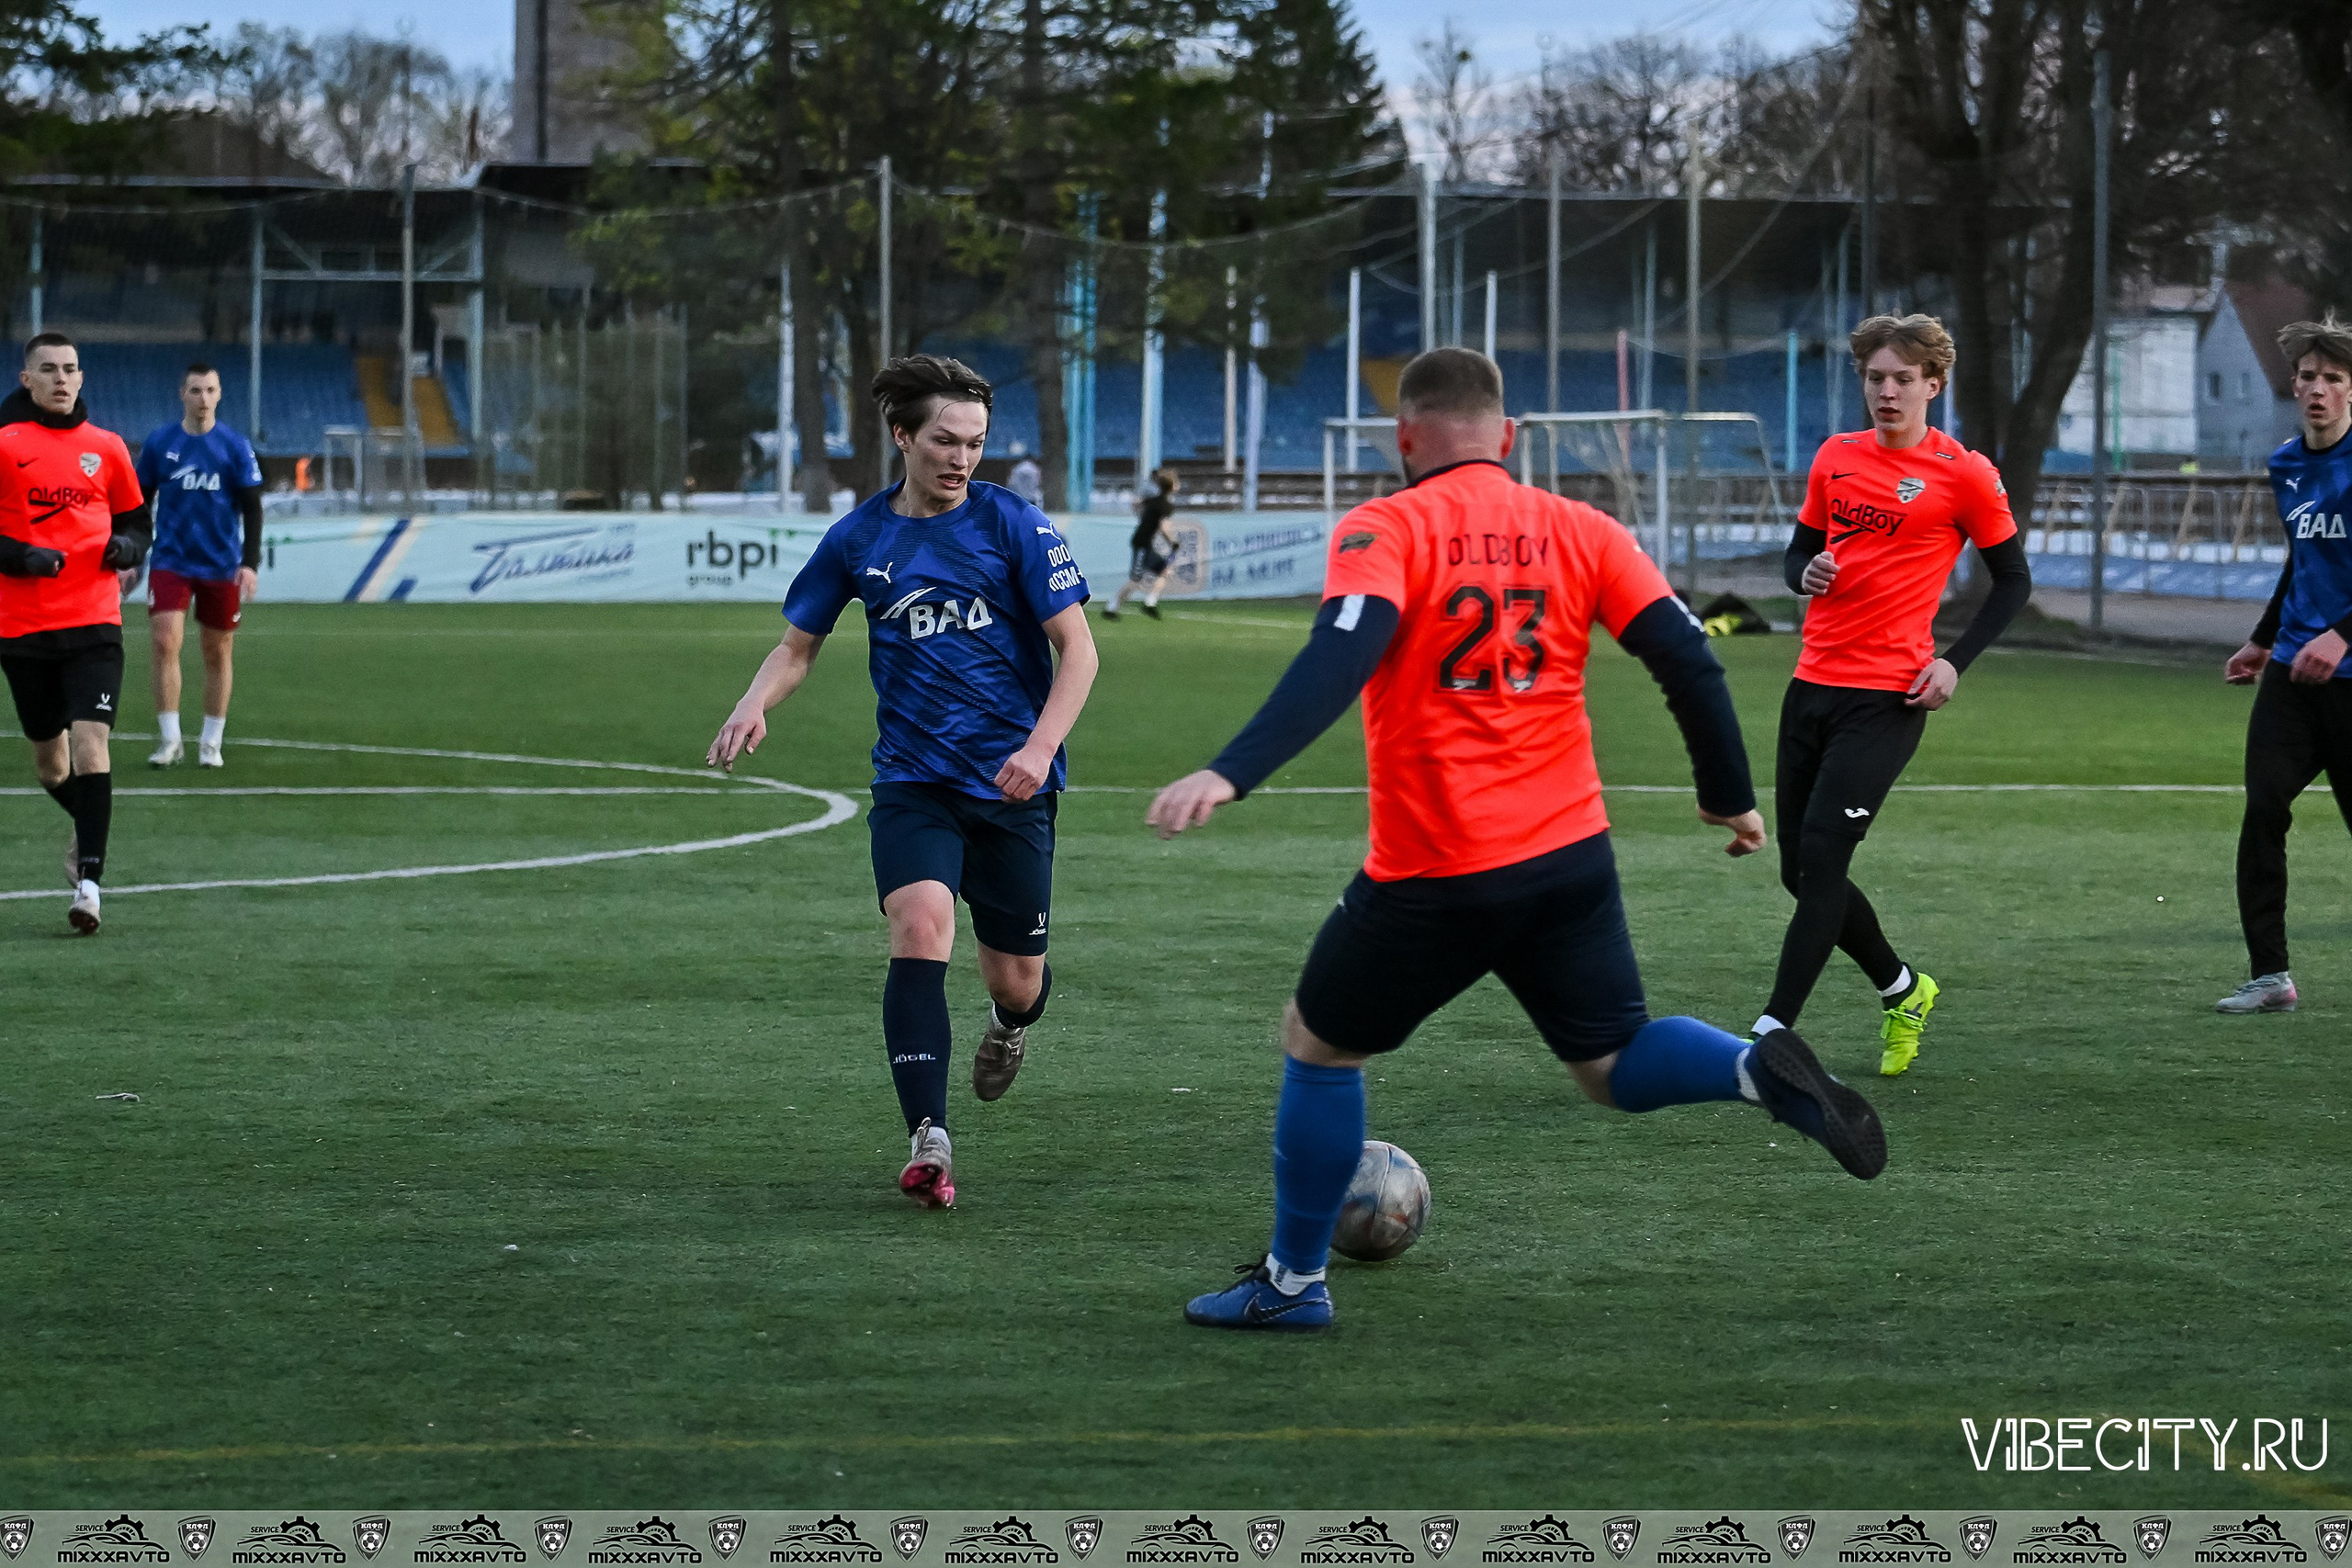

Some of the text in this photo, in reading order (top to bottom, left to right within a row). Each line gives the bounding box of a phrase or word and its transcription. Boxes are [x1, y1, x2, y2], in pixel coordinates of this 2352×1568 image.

[686, 526, 777, 580] rbpi
[1448, 534, 1548, 567] OLDBOY
[1436, 584, 1550, 694] 23
